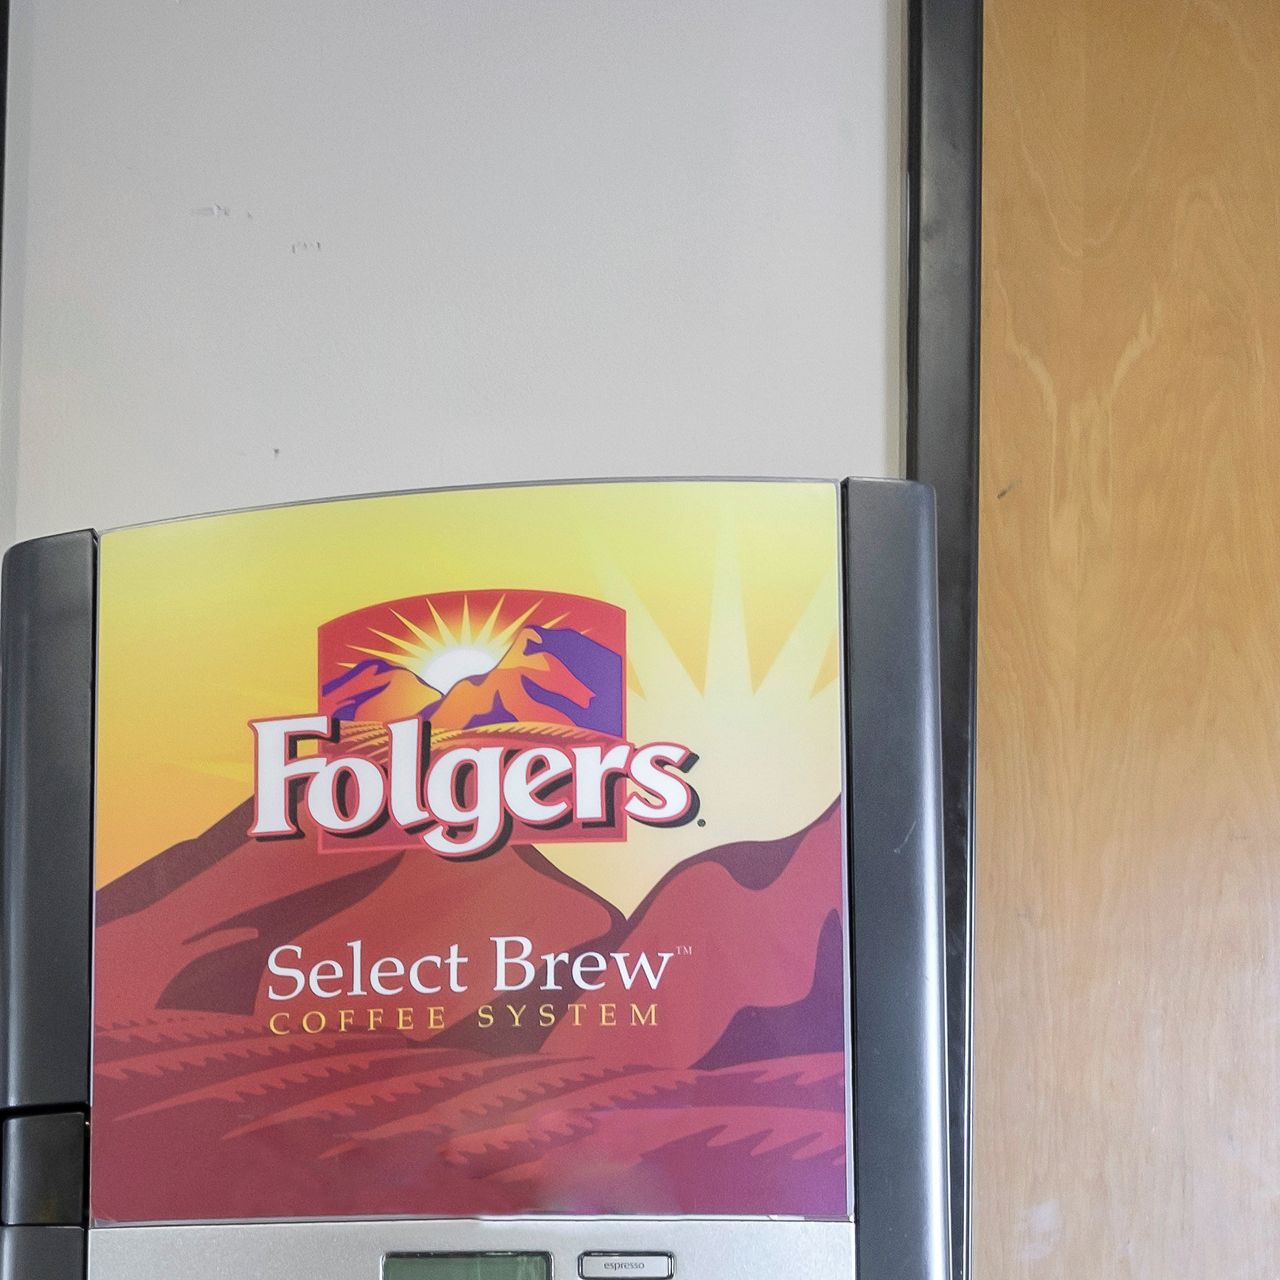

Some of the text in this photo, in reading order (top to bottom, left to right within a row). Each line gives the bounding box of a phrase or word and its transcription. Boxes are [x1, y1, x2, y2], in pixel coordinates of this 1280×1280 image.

[247, 713, 697, 859] Folgers
[266, 940, 469, 1001] Select
[269, 1003, 659, 1036] COFFEE SYSTEM
[603, 1261, 645, 1271] espresso
